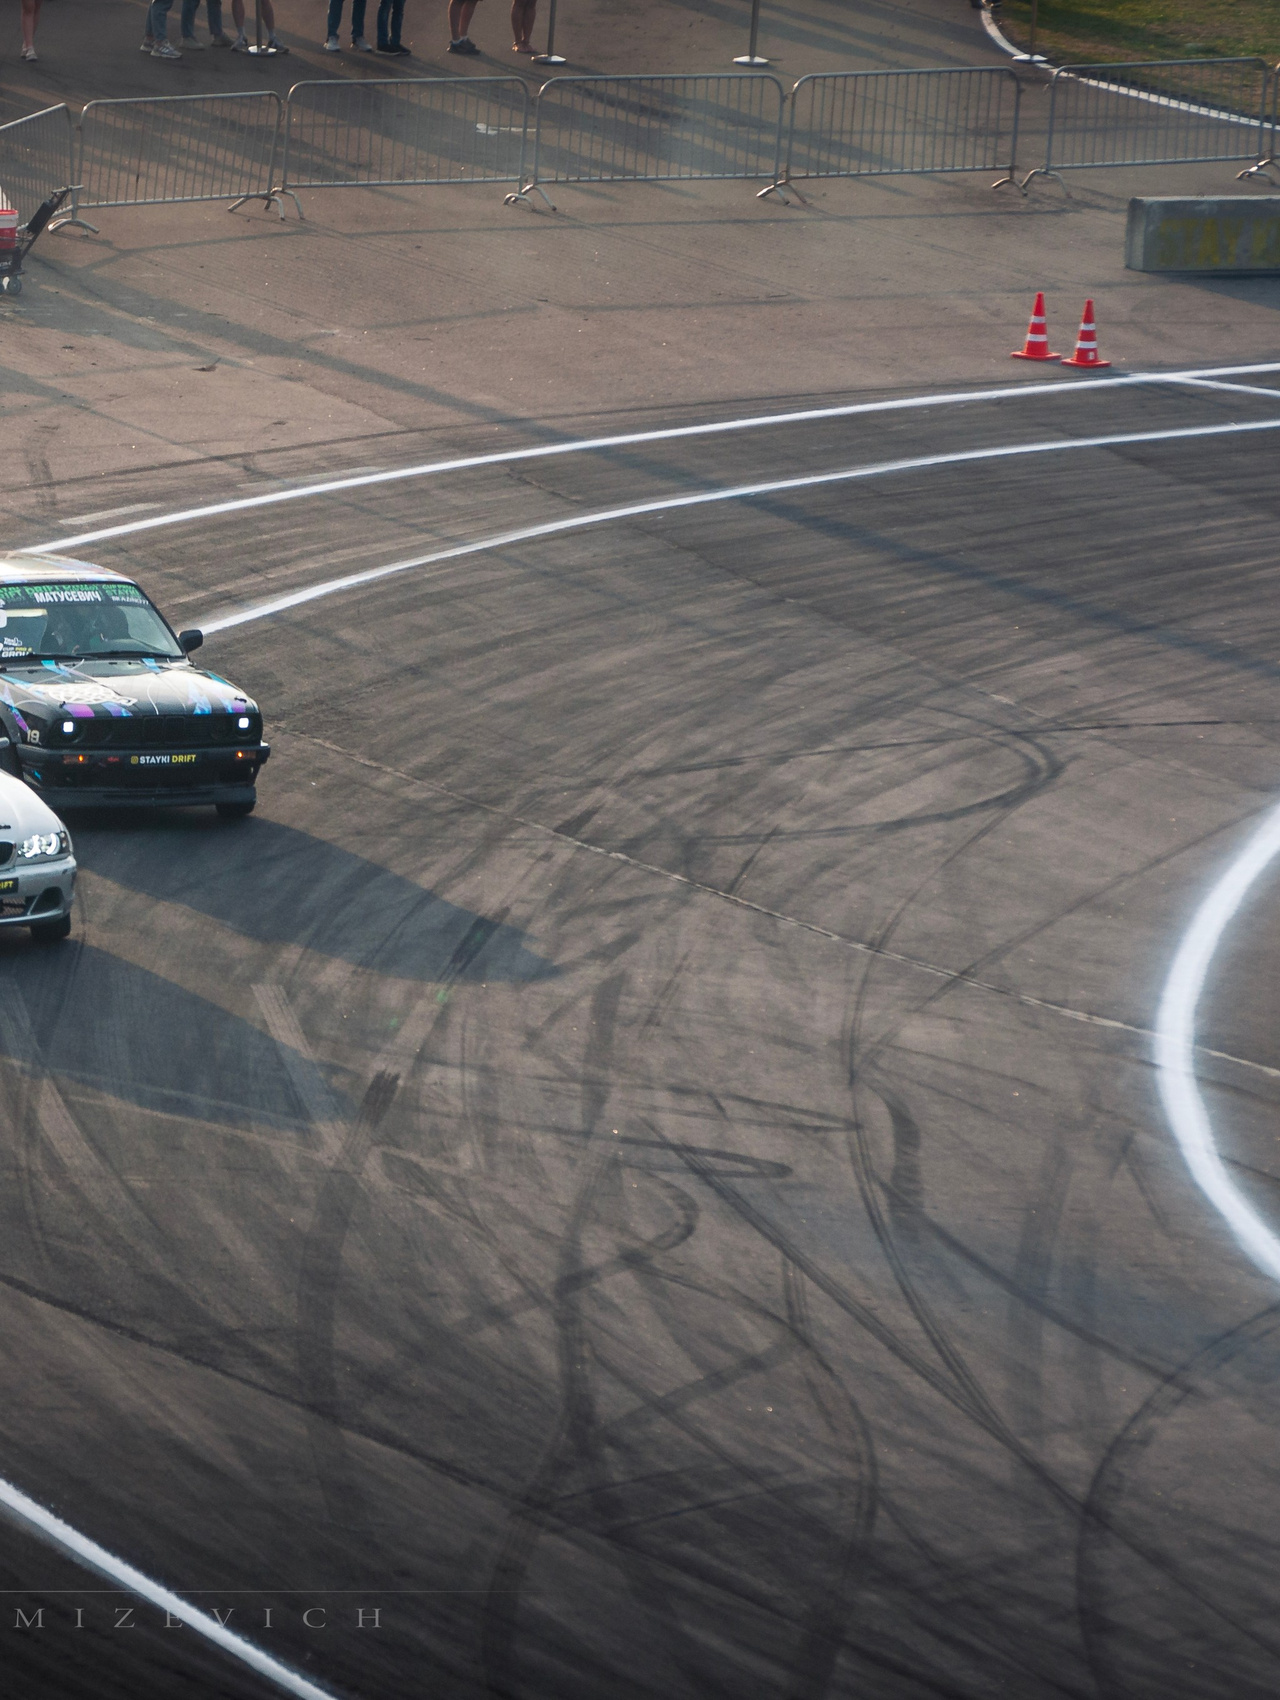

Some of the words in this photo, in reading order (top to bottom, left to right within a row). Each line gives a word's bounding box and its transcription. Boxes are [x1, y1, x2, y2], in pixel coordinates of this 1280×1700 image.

[33, 591, 102, 604] МАТУСЕВИЧ
[26, 729, 40, 744] 19
[139, 755, 171, 765] STAYKI
[171, 754, 197, 764] DRIFT
